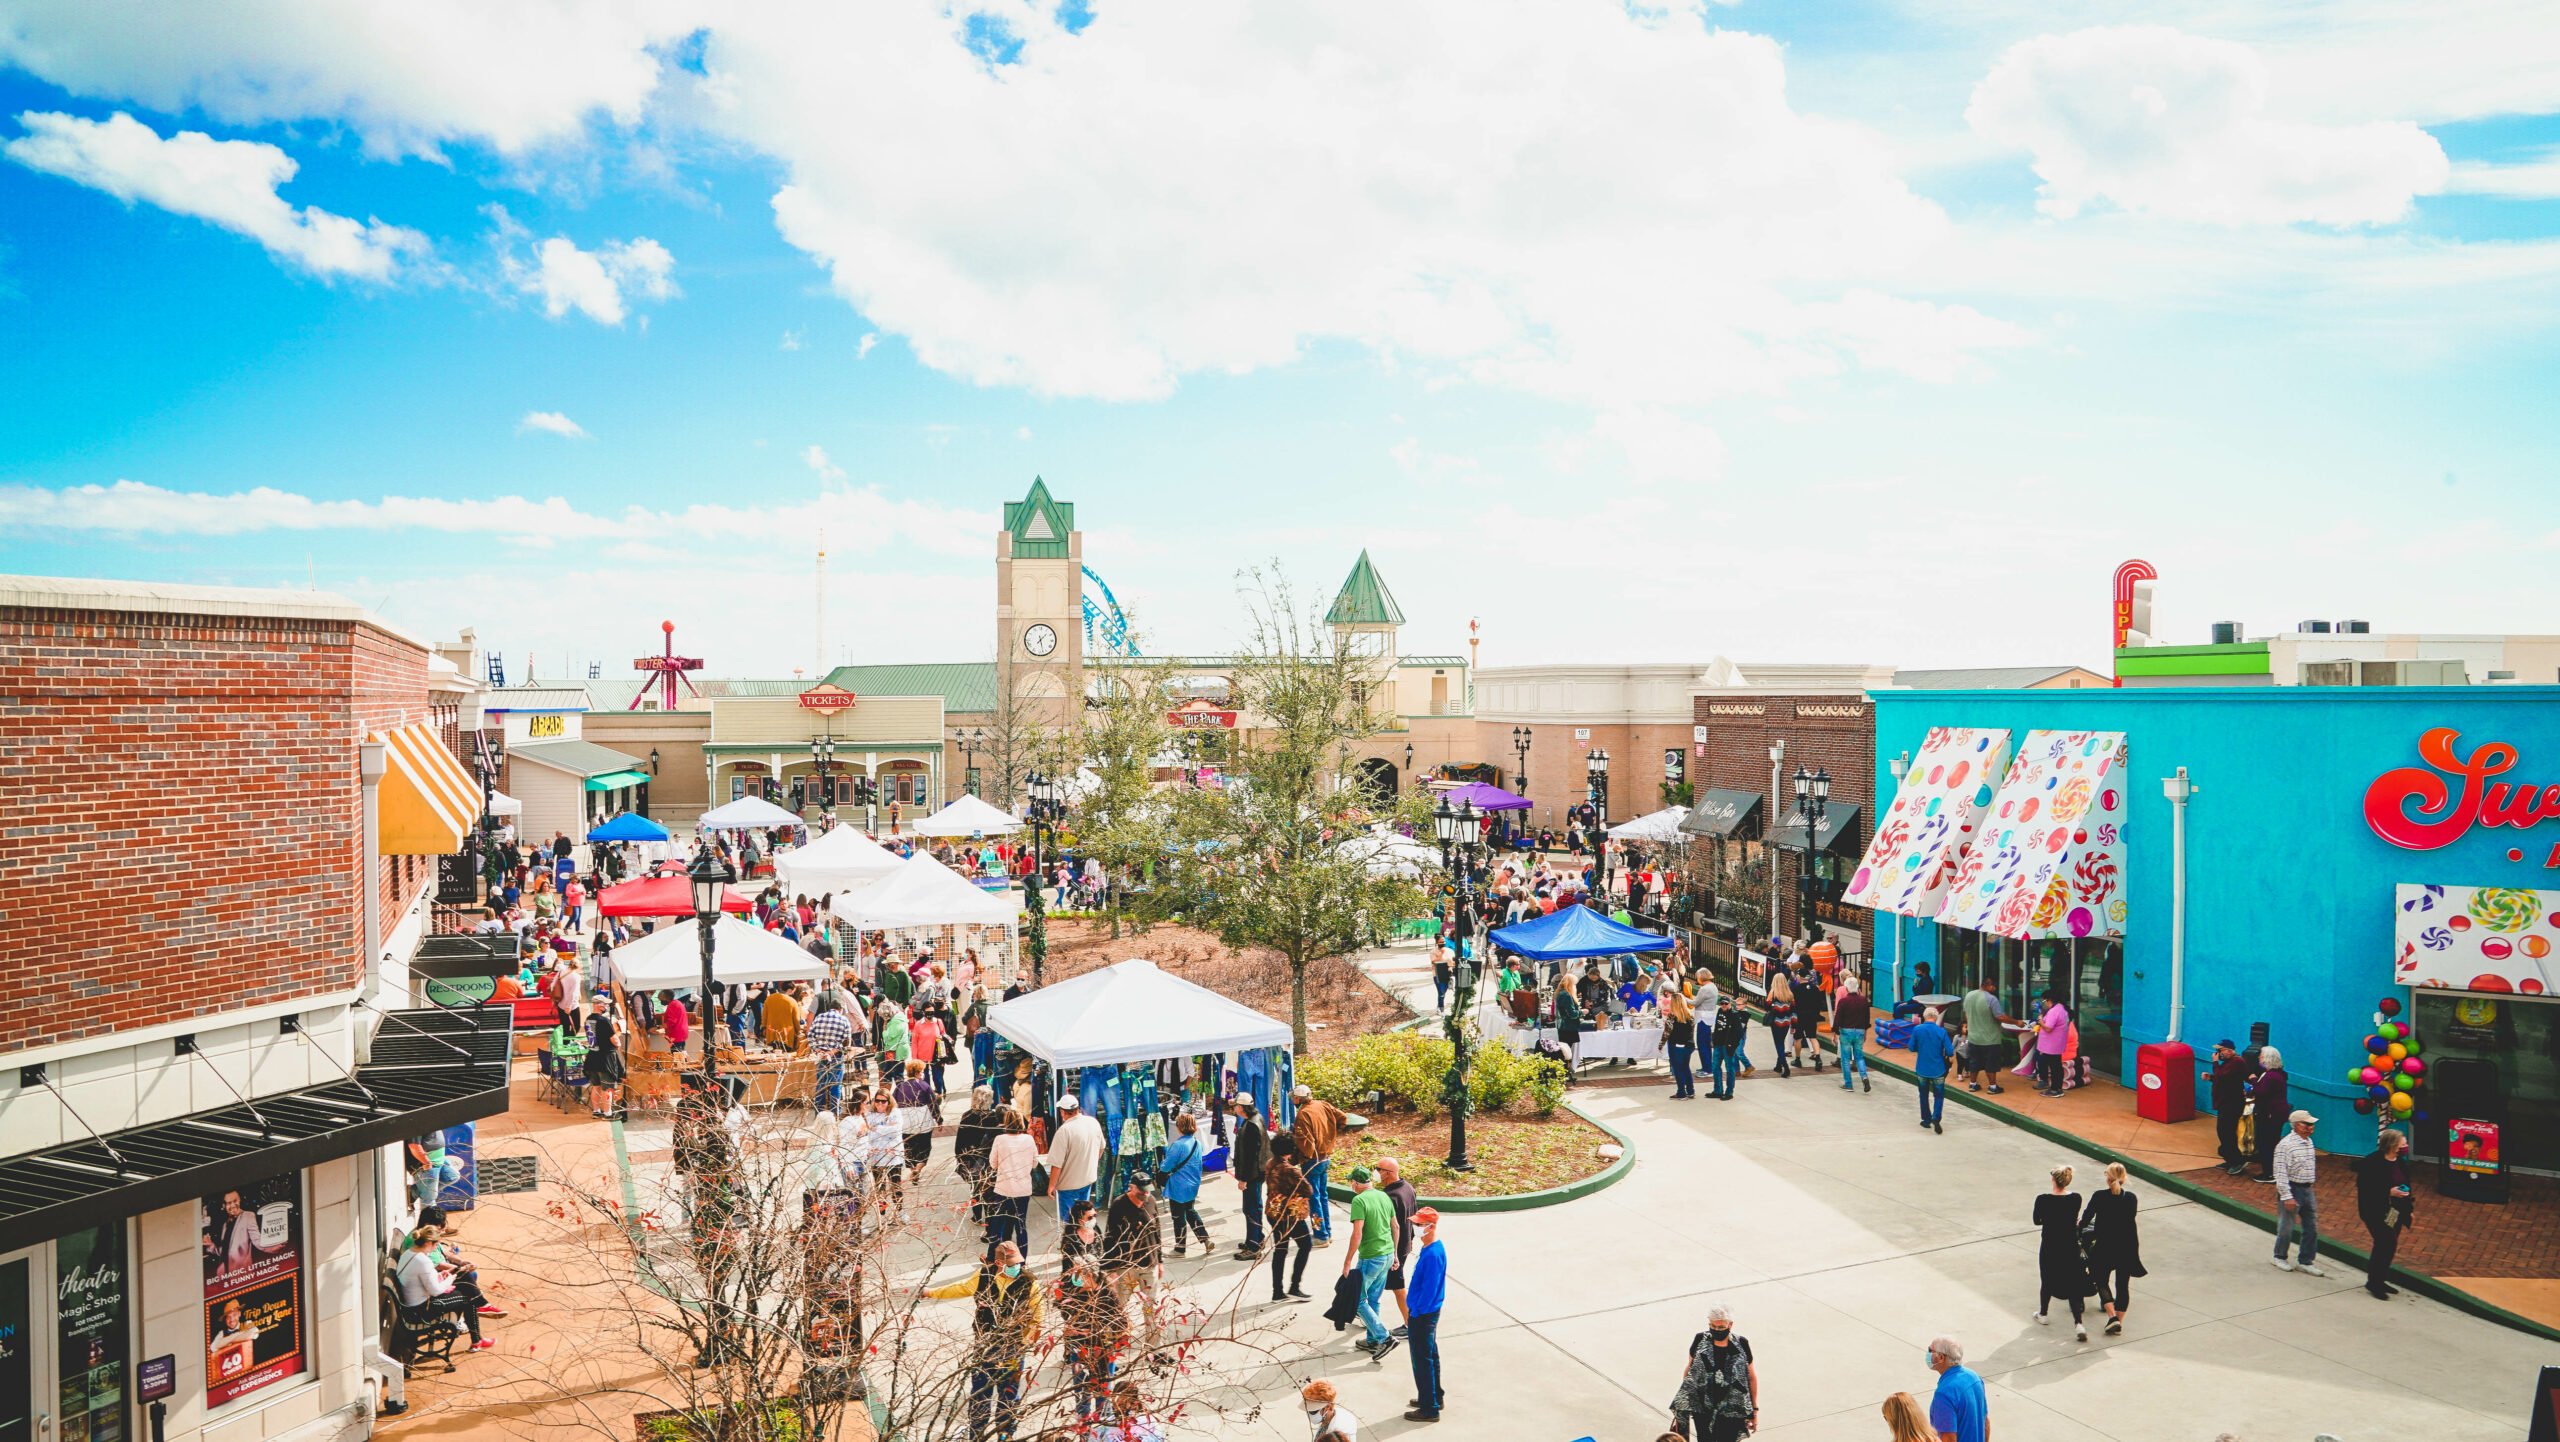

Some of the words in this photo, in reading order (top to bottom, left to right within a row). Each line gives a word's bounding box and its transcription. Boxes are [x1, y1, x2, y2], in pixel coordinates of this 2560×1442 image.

[634, 659, 662, 670] TWISTER
[804, 695, 850, 705] TICKETS
[530, 715, 565, 737] ARCADE
[1184, 713, 1198, 725] THE
[1199, 712, 1222, 725] PARK
[441, 859, 452, 870] &
[429, 983, 493, 993] RESTROOMS
[263, 1224, 287, 1235] MAGIC
[206, 1275, 220, 1286] BIG
[220, 1266, 247, 1281] MAGIC,
[247, 1259, 271, 1272] LITTLE
[272, 1250, 295, 1263] MAGIC
[230, 1273, 255, 1286] FUNNY
[256, 1264, 280, 1277] MAGIC
[58, 1263, 121, 1300] theater
[86, 1291, 94, 1301] &
[58, 1303, 92, 1320] Magic
[93, 1294, 121, 1308] Shop
[243, 1307, 261, 1320] Trip
[262, 1299, 287, 1314] Down
[273, 1307, 293, 1321] Lane
[222, 1353, 242, 1370] 40
[227, 1387, 240, 1396] VIP
[240, 1369, 283, 1391] EXPERIENCE
